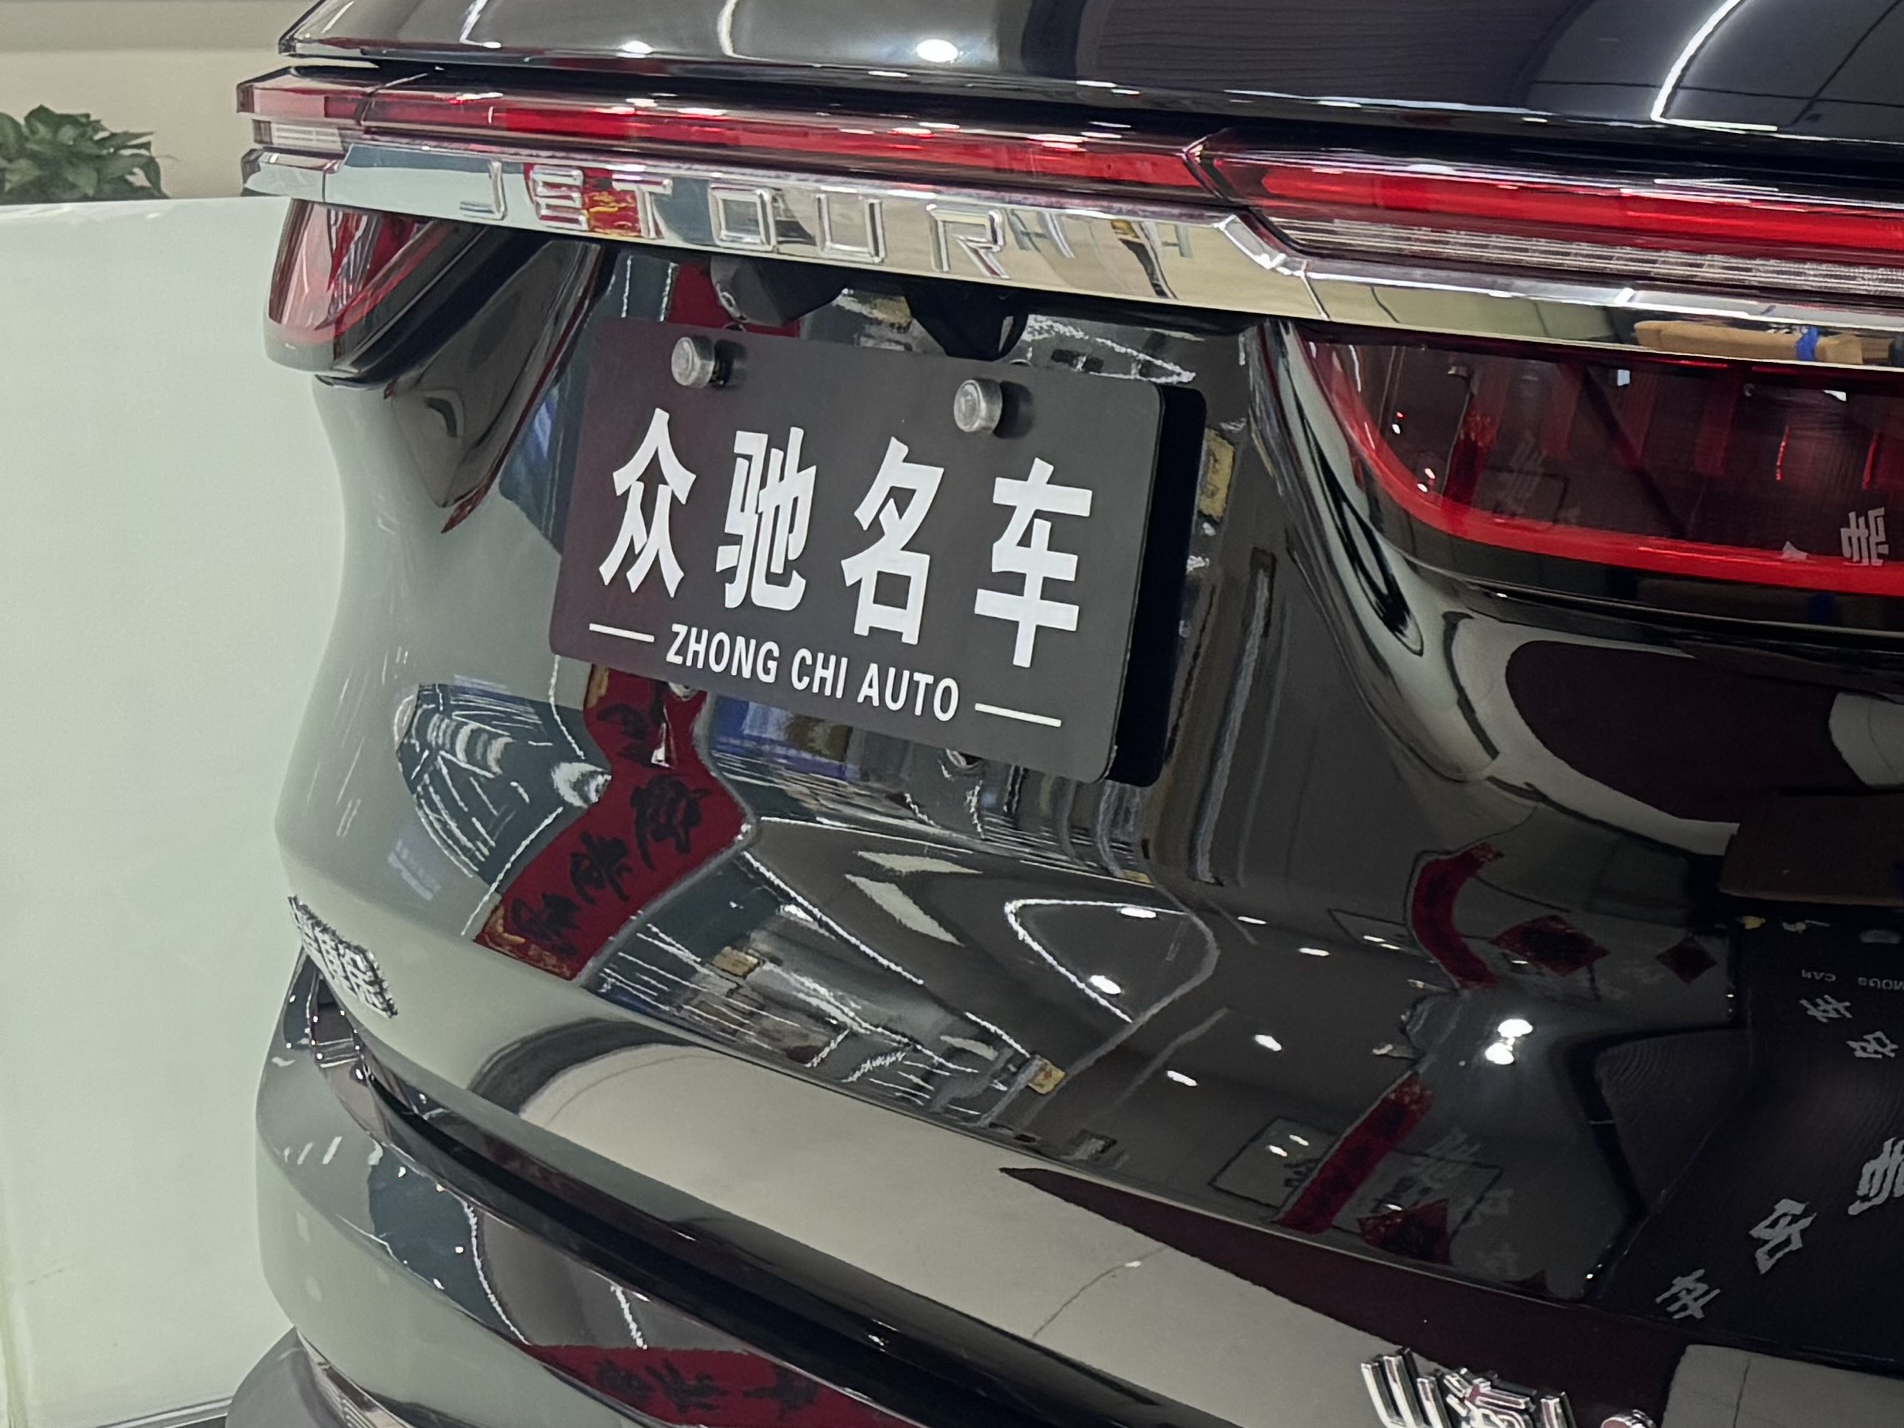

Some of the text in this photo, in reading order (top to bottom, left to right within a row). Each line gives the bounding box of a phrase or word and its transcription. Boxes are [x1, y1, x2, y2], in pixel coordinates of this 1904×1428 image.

[459, 160, 1010, 279] JETOUR
[598, 408, 1092, 670] 众驰名车
[666, 622, 961, 723] ZHONG CHI AUTO
